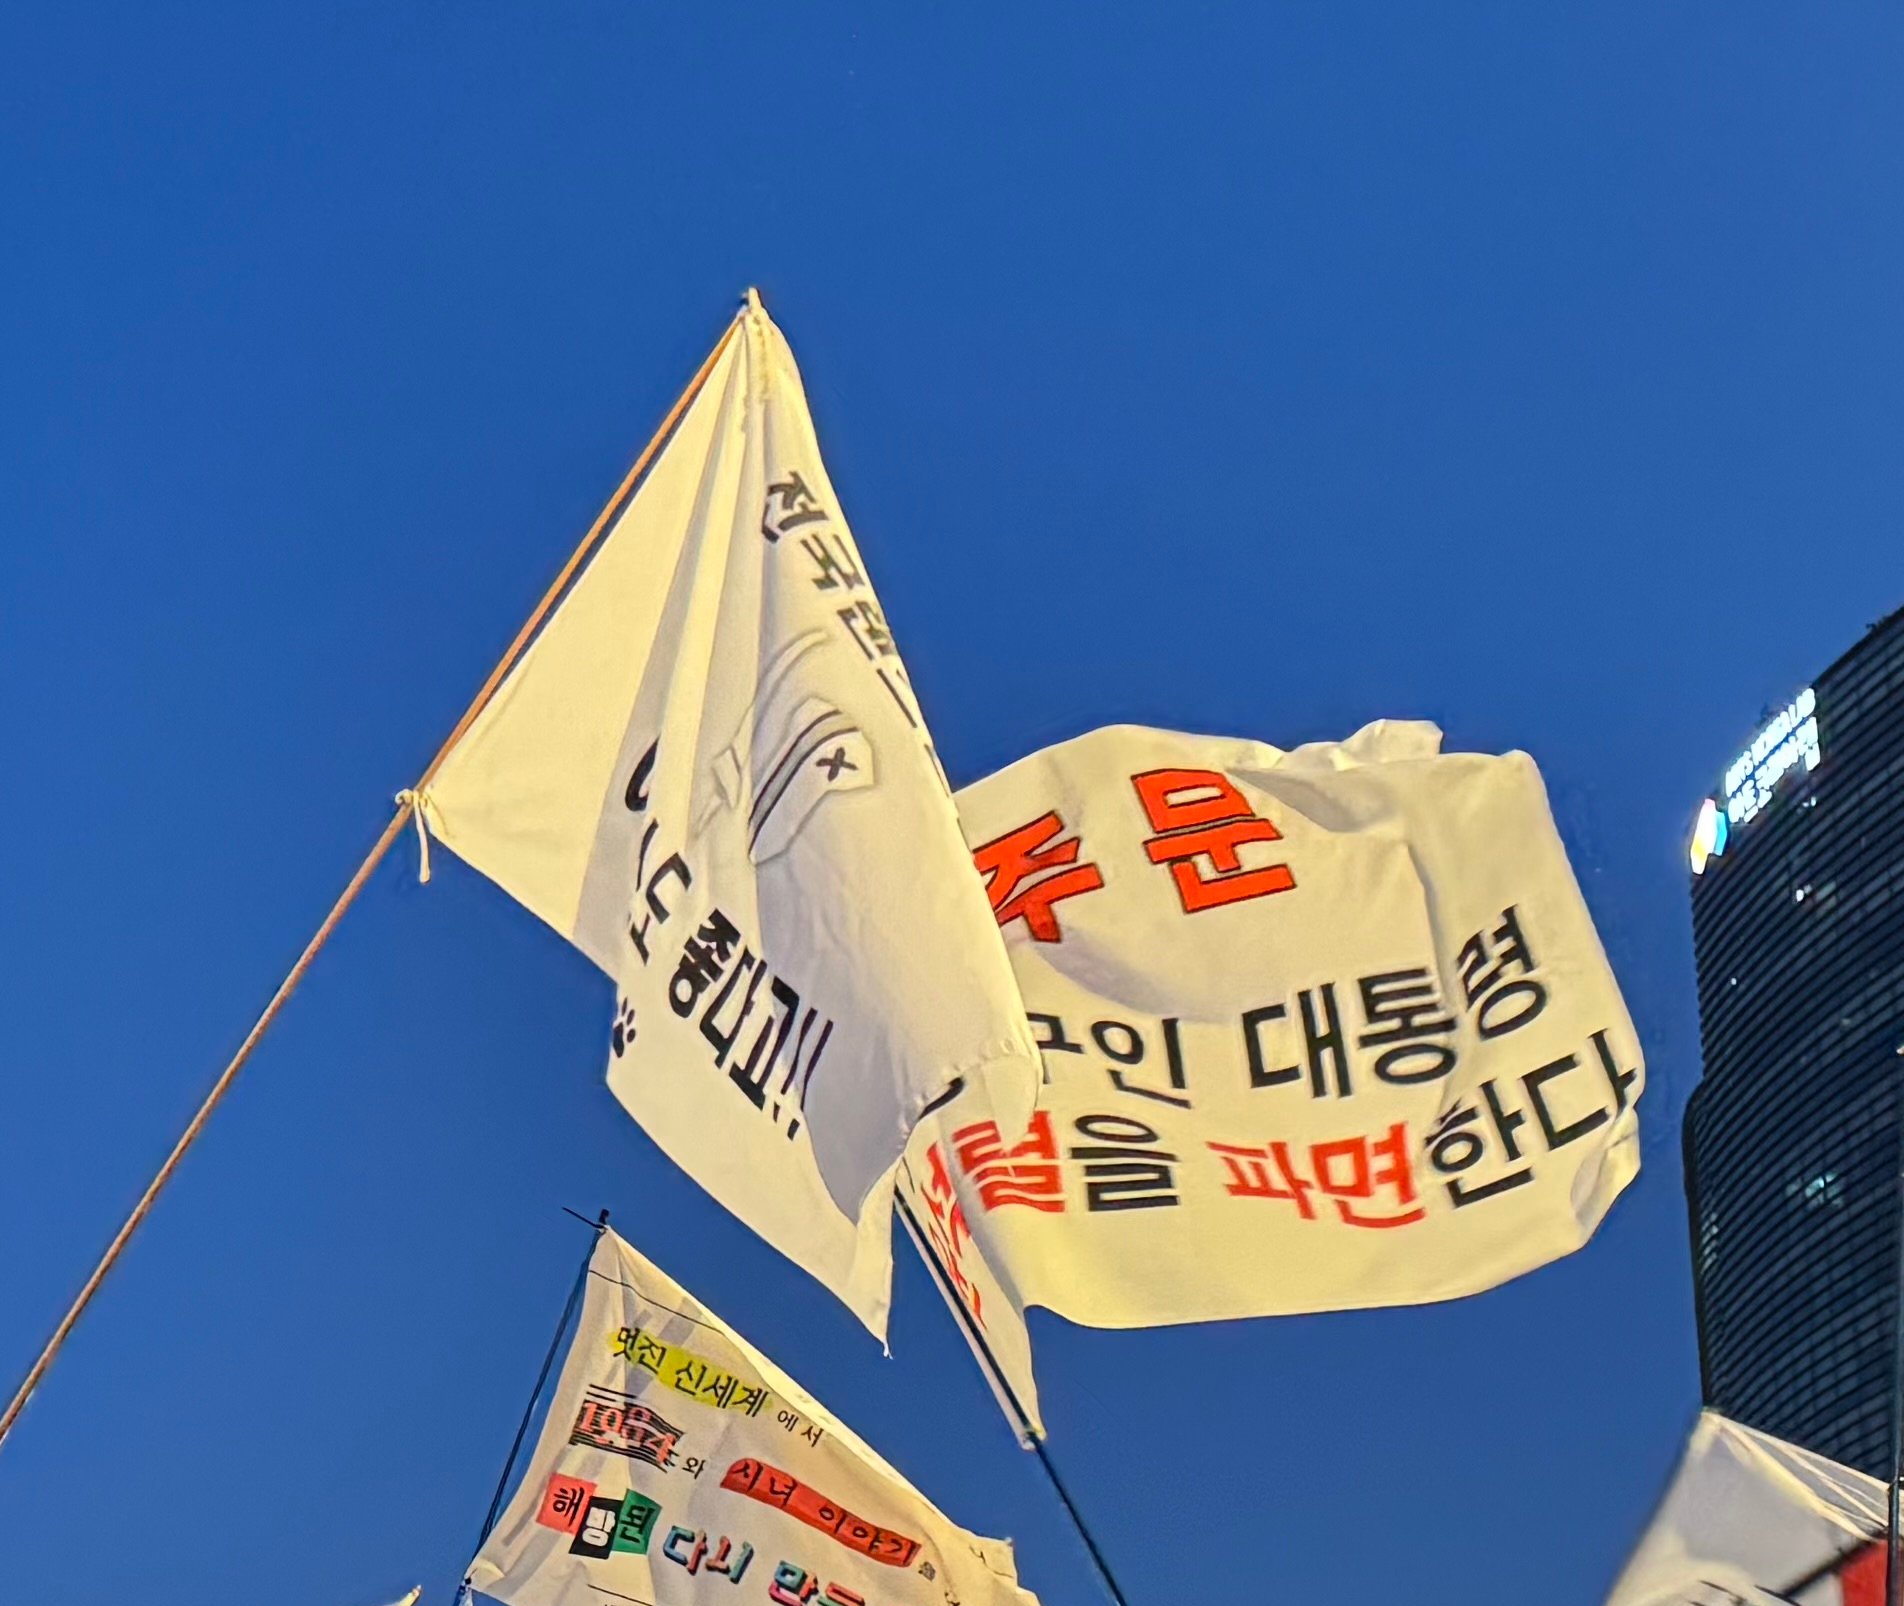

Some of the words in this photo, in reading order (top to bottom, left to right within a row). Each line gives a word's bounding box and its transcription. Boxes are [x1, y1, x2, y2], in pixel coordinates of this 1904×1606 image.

[1241, 905, 1548, 1102] 대통령
[613, 1326, 667, 1376] 멋진
[728, 1457, 795, 1503] 시녀
[663, 1524, 754, 1585] 다시
